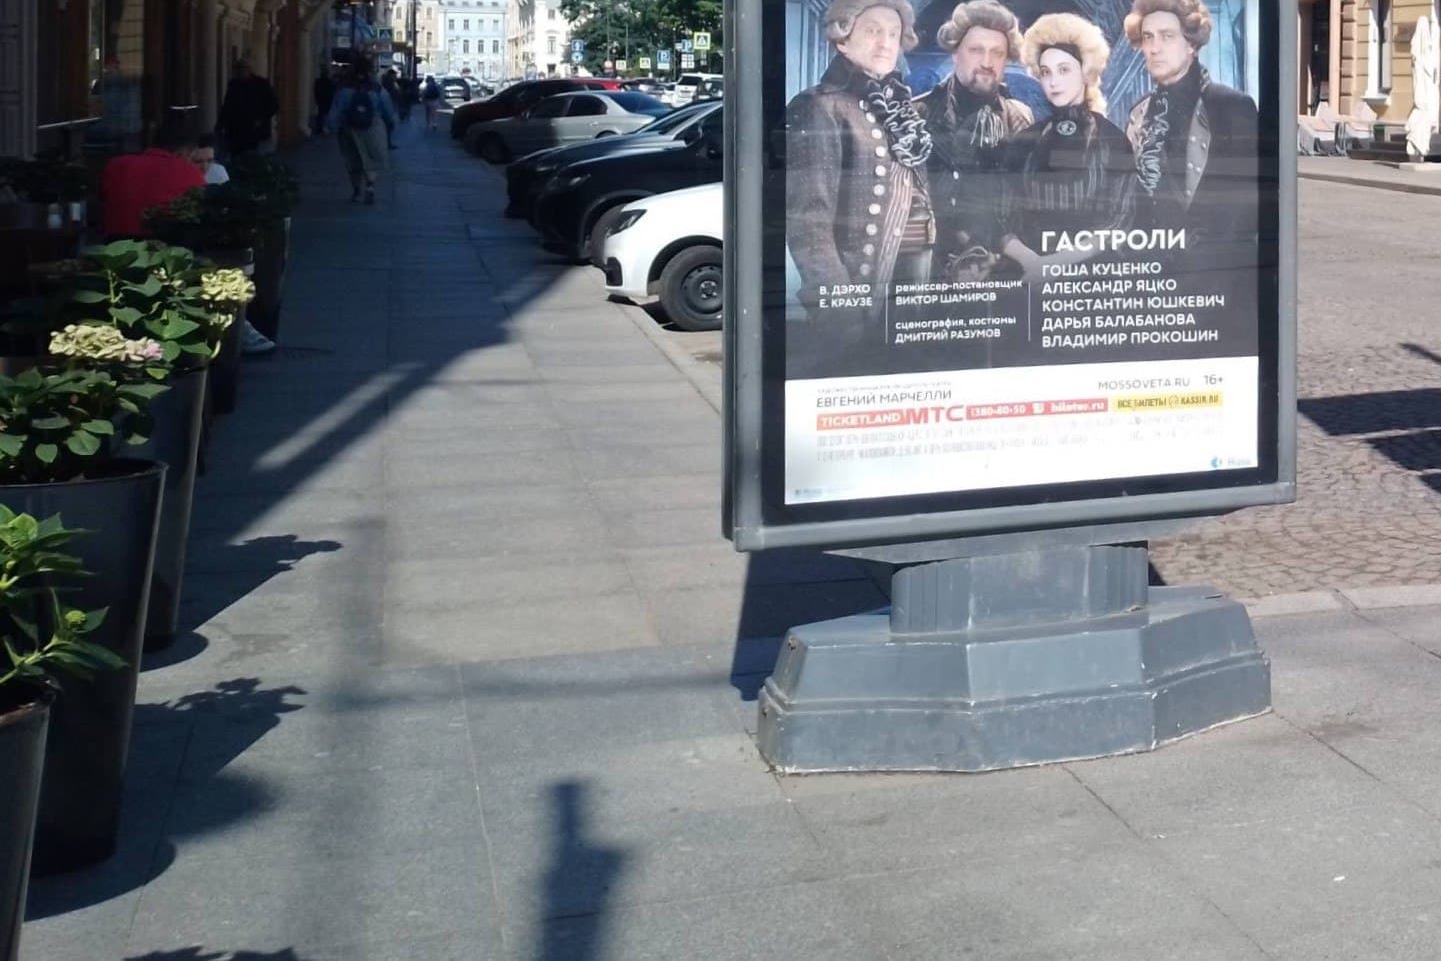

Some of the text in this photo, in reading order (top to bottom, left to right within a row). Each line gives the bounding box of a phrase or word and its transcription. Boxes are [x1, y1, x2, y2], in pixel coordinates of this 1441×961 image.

[1041, 228, 1186, 252] ГАСТРОЛИ
[1042, 261, 1162, 278] ГОША КУЦЕНКО
[819, 284, 871, 296] В. ДЭРХО
[895, 280, 1023, 293] режиссер-постановщик
[1042, 279, 1177, 295] АЛЕКСАНДР ЯЦКО
[819, 297, 873, 308] Е. КРАУЗЕ
[895, 292, 997, 305] ВИКТОР ШАМИРОВ
[1042, 295, 1225, 312] КОНСТАНТИН ЮШКЕВИЧ
[895, 316, 1017, 330] сценография, костюмы
[1042, 313, 1196, 332] ДАРЬЯ БАЛАБАНОВА
[895, 328, 1001, 343] ДМИТРИЙ РАЗУМОВ
[1042, 330, 1218, 349] ВЛАДИМИР ПРОКОШИН
[1098, 374, 1223, 390] MOSSOVETA.RU 16+
[816, 390, 952, 408] ЕВГЕНИЙ МАРЧЕЛЛИ
[821, 412, 902, 427] TICKETLAND
